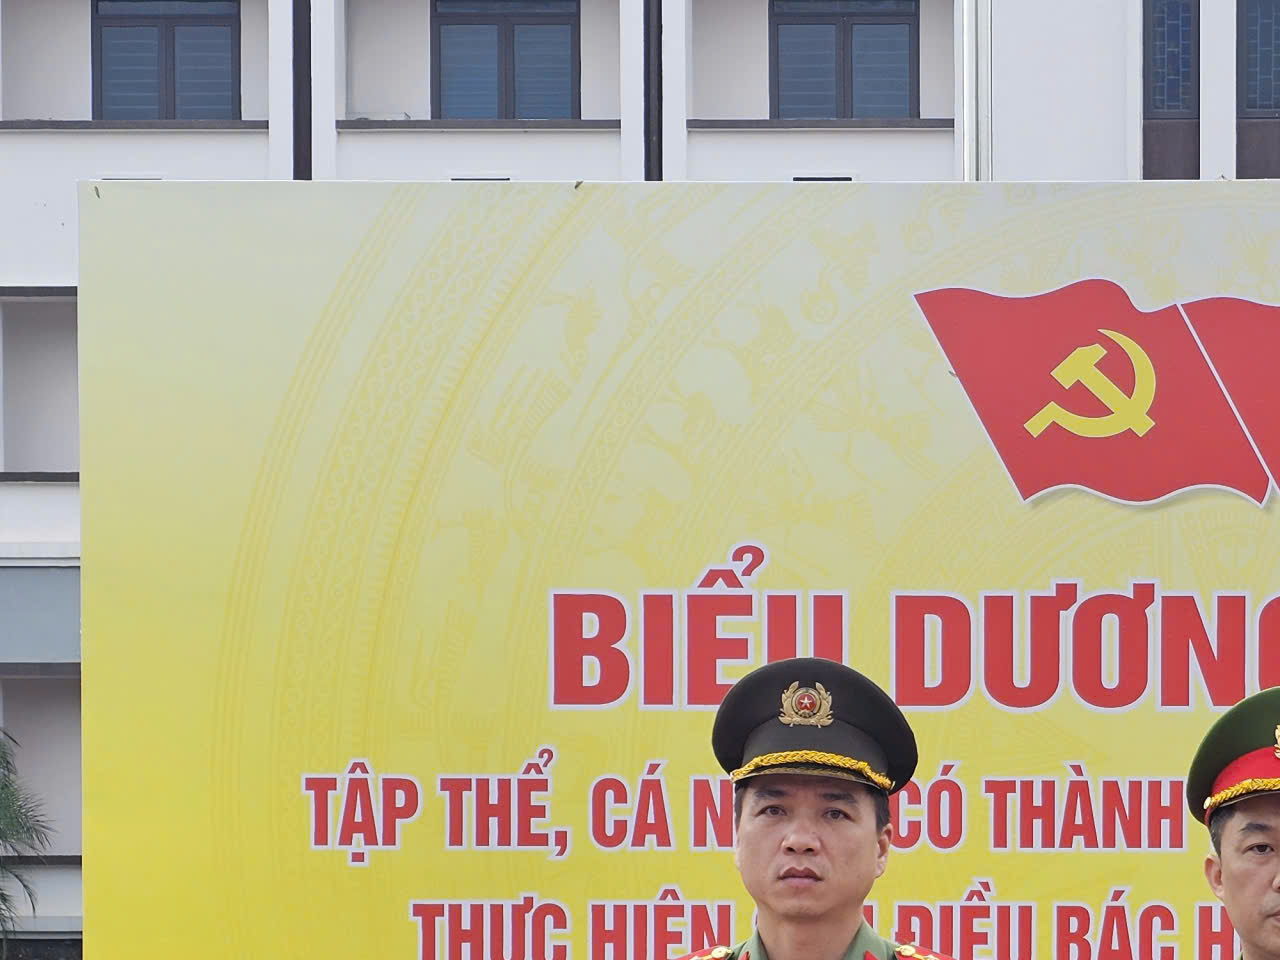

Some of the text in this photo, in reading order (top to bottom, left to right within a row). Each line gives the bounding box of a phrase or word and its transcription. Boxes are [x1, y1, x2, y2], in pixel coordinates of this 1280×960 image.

[553, 545, 845, 706] BIỂU
[304, 762, 419, 863] TẬP
[440, 748, 569, 857] THỂ,
[591, 763, 672, 848] CÁ
[888, 763, 964, 850] CÓ
[984, 765, 1184, 850] THÀNH
